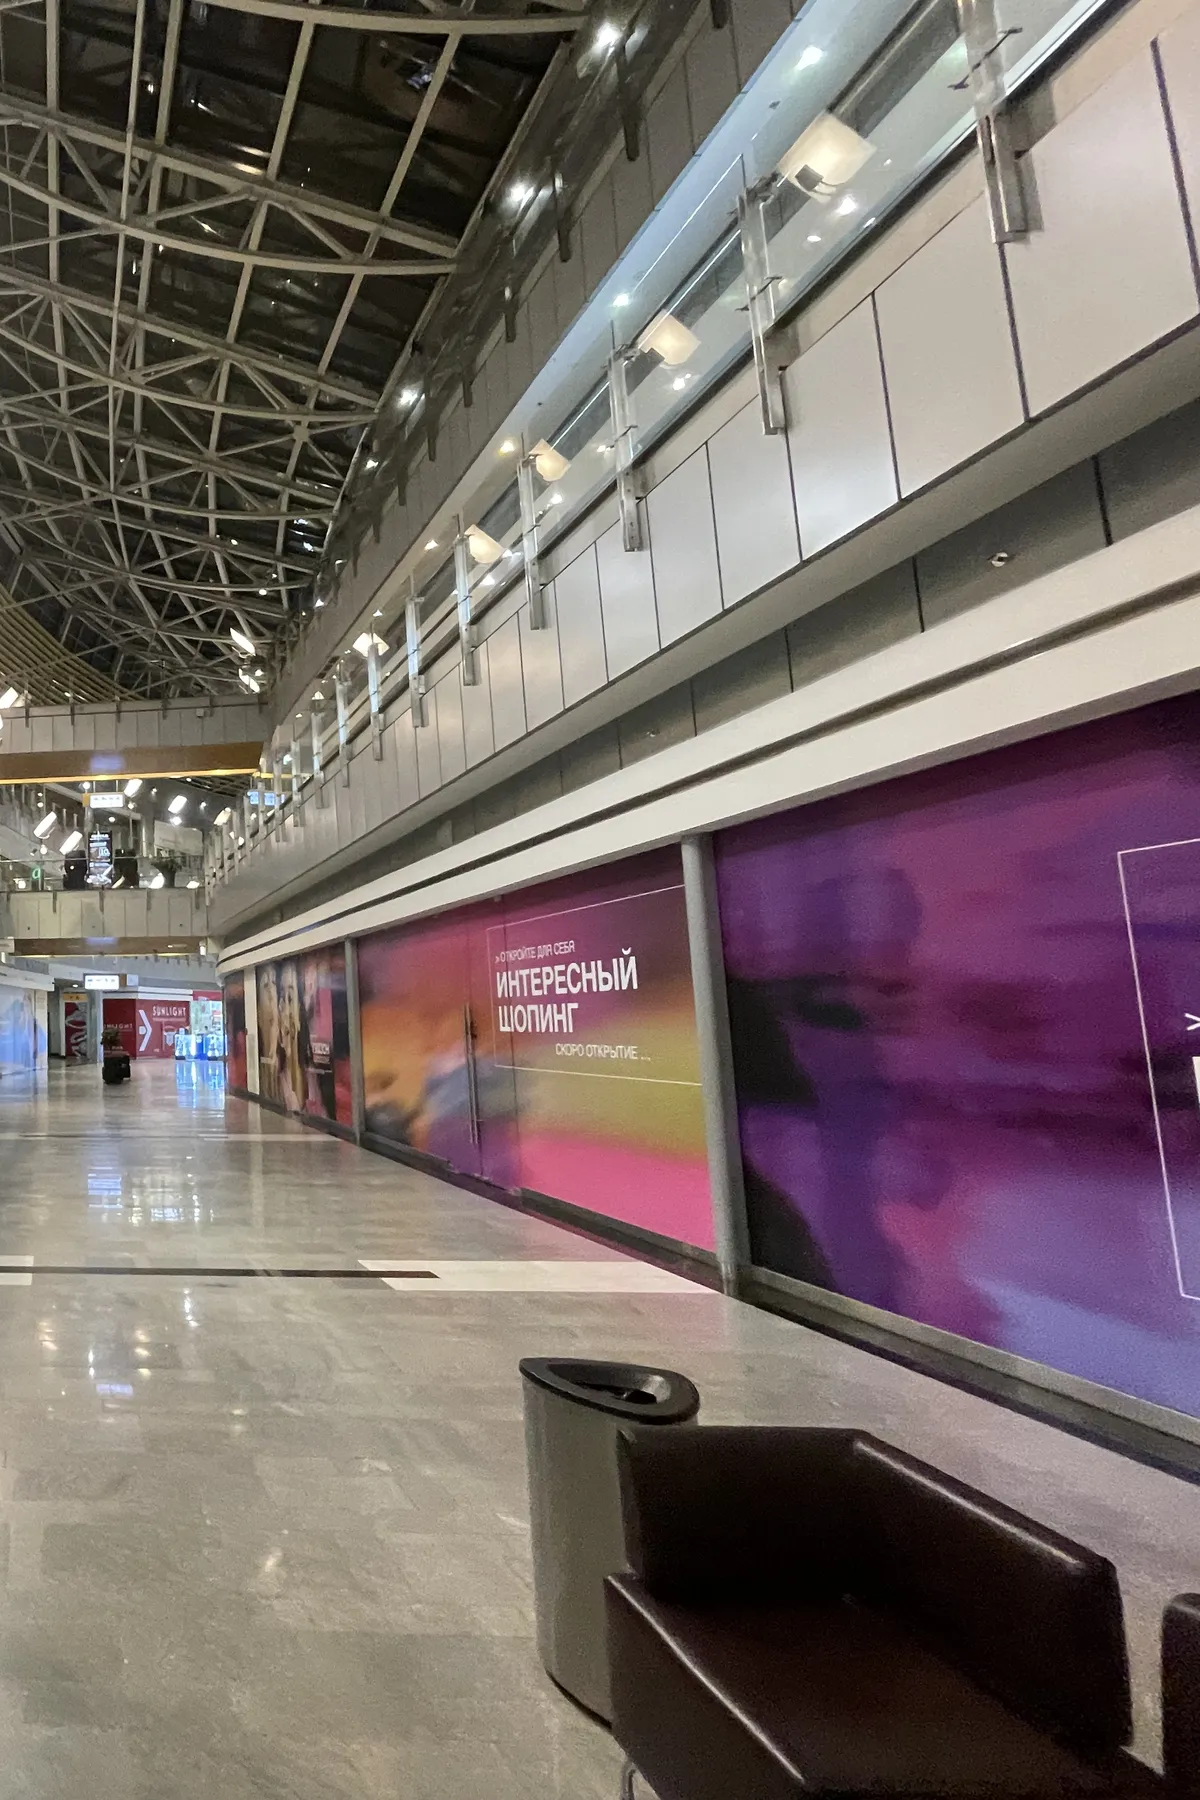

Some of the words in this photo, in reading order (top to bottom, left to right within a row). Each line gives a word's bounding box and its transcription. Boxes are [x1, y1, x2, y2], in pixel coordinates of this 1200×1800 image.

[499, 945, 536, 962] ОТКРОЙТЕ
[536, 943, 553, 959] ДЛЯ
[553, 939, 575, 956] СЕБЯ
[496, 946, 638, 999] ИНТЕРЕСНЫЙ
[152, 1006, 186, 1017] SUNLIGHT
[498, 1003, 579, 1033] ШОПИНГ
[555, 1043, 584, 1057] СКОРО
